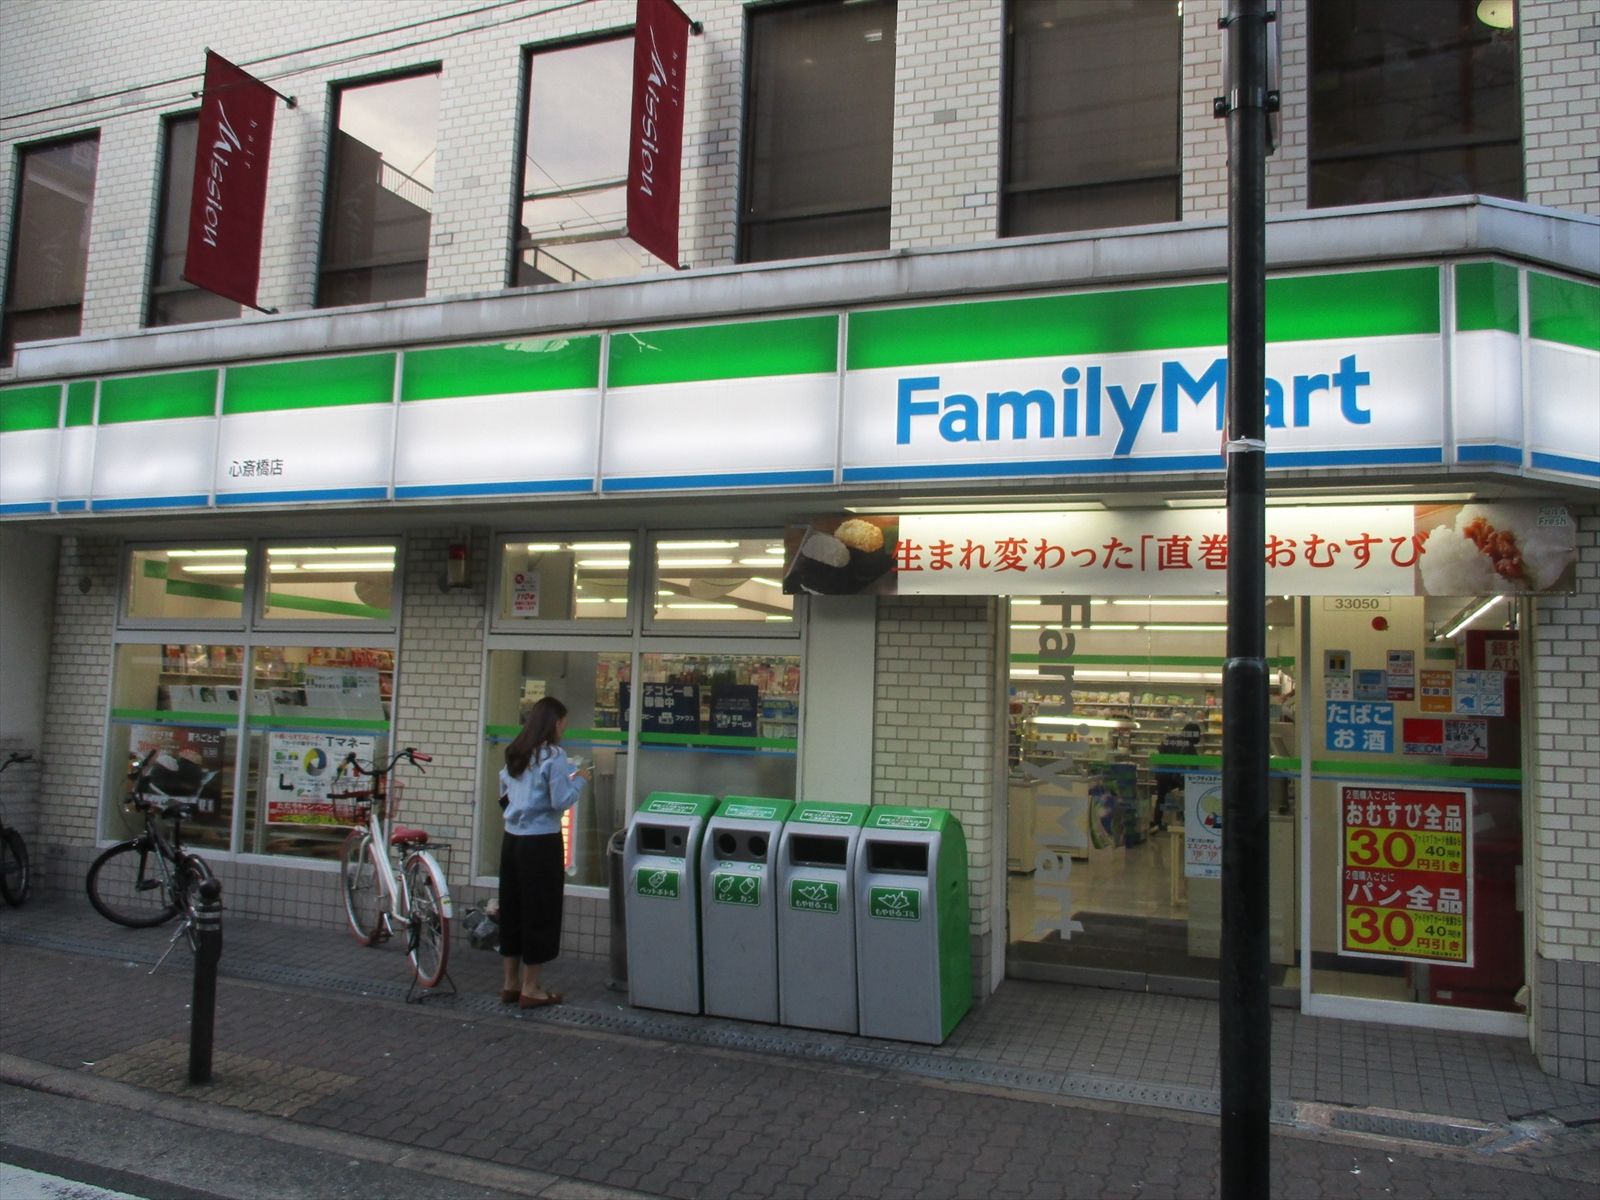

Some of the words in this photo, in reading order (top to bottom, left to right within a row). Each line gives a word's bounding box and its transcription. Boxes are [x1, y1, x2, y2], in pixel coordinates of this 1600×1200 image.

[640, 25, 668, 197] Mission
[202, 99, 242, 248] Mission
[229, 458, 283, 477] 心斎橋店
[891, 530, 1430, 573] 生まれ変わった「直巻おむすび
[1335, 598, 1380, 610] 33050
[1327, 703, 1393, 726] たばこ
[325, 735, 371, 749] Tマネー
[1333, 729, 1386, 751] お酒
[1346, 801, 1463, 832] おむすび全品
[1349, 829, 1416, 868] 30
[1417, 858, 1460, 872] 円引き
[1347, 882, 1463, 914] パン全品
[1349, 907, 1415, 947] 30
[1417, 937, 1460, 951] 円引き
